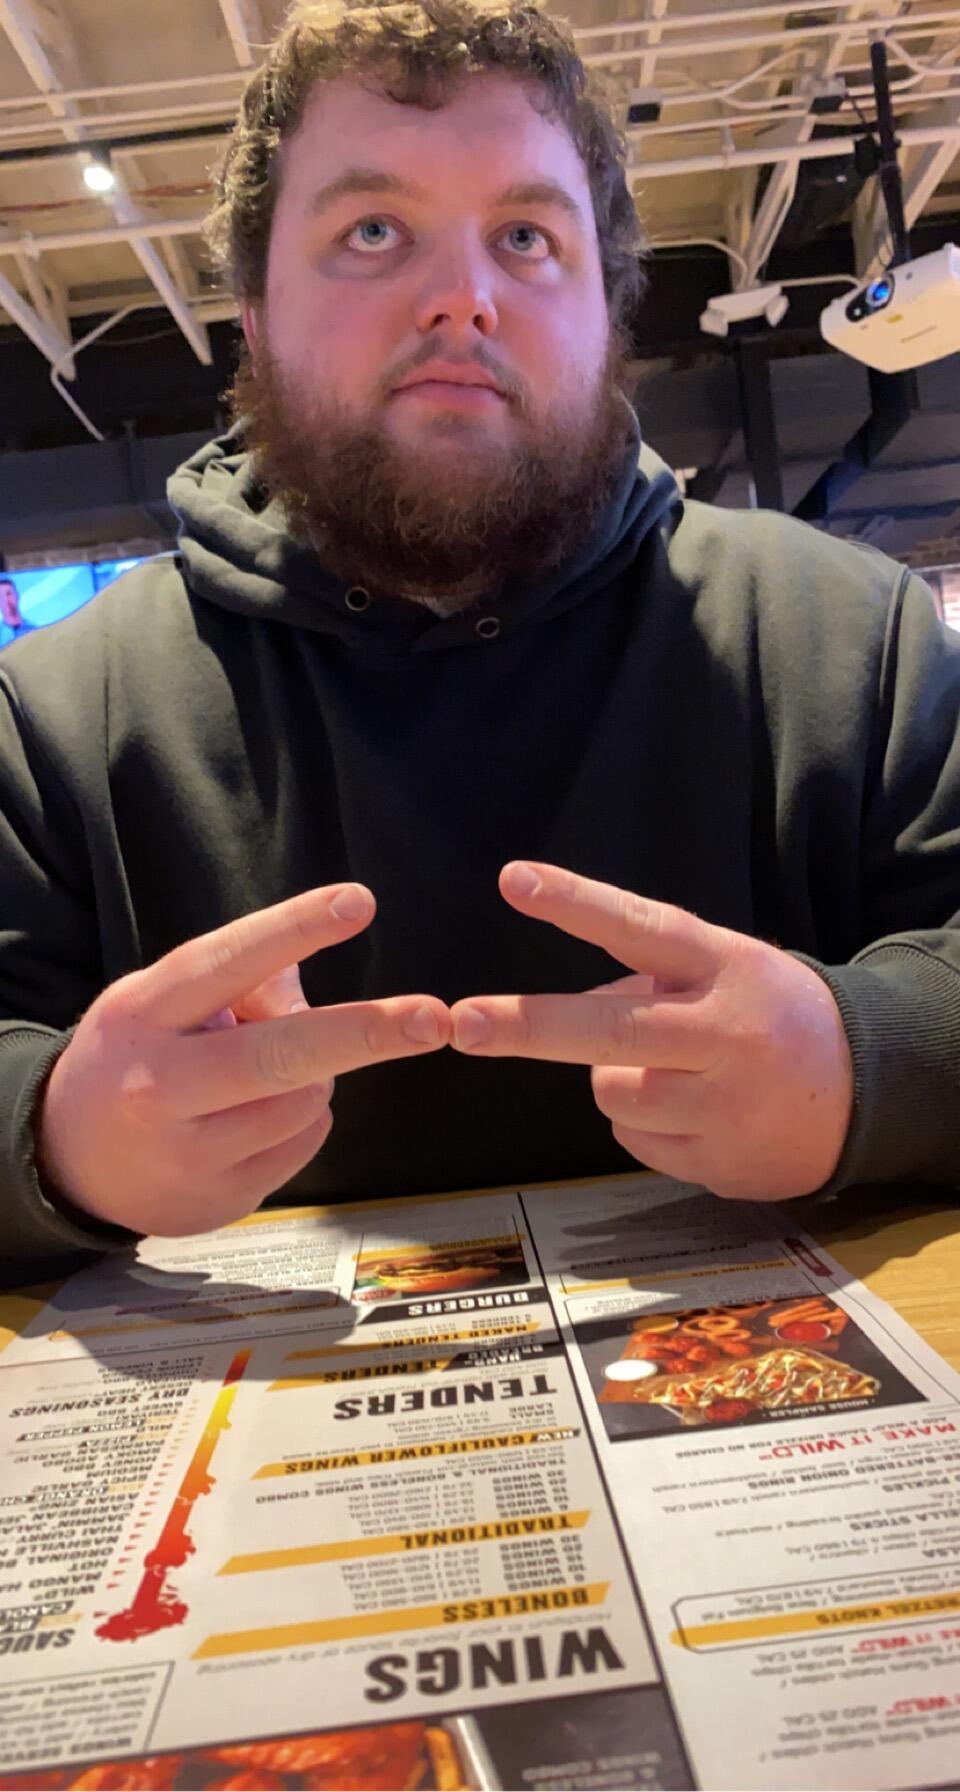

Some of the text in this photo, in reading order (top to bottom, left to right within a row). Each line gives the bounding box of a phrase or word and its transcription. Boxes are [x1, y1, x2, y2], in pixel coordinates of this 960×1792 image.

[407, 1292, 529, 1315] BURGERS
[468, 1325, 528, 1339] NAKED
[380, 1332, 460, 1349] TENDERS
[467, 1344, 544, 1360] BREADED
[322, 1359, 439, 1383] TENDERS
[8, 1388, 190, 1419] DRY SEASONINGS
[332, 1373, 558, 1421] TENDERS
[134, 1400, 183, 1412] SWEET
[768, 1398, 868, 1419] HOUSE SAMPLER
[114, 1408, 179, 1421] TERIYAKI
[25, 1419, 140, 1441] LEMON PEPPER
[135, 1423, 173, 1433] MILD
[535, 1430, 575, 1442] NEW
[880, 1422, 957, 1441] MAKE
[86, 1435, 132, 1447] PIZZA
[369, 1435, 525, 1463] CAULIFLOWER
[848, 1434, 873, 1448] IT
[13, 1439, 166, 1464] PARMESAN GARLIC
[42, 1447, 161, 1467] SMOKY ADOBO
[62, 1455, 158, 1473] HONEY BBQ
[86, 1464, 153, 1478] MEDIUM
[284, 1454, 360, 1475] WINGS
[468, 1459, 567, 1476] TRADITIONAL
[854, 1451, 960, 1475] ER-BATTERED
[31, 1473, 149, 1493] SPICY GARLIC
[369, 1472, 446, 1489] BONELESS
[491, 1469, 565, 1485] 30 WINGS
[745, 1475, 796, 1491] RINGS
[798, 1467, 850, 1483] ONION
[314, 1483, 364, 1496] WINGS
[493, 1477, 567, 1493] 20 WINGS
[552, 1486, 567, 1494] 15
[881, 1475, 950, 1493] PICKLES
[38, 1488, 103, 1501] ORANGE
[85, 1492, 140, 1506] ASIAN
[255, 1490, 310, 1504] COMBO
[495, 1488, 546, 1501] WINGS
[553, 1495, 570, 1503] 10
[32, 1502, 135, 1521] CARIBBEAN
[495, 1497, 547, 1510] WINGS
[499, 1505, 552, 1519] WINGS
[848, 1507, 960, 1532] ELLA STICKS
[0, 1523, 47, 1535] JALA
[16, 1524, 122, 1544] THAI CURRY
[400, 1515, 573, 1549] TRADITIONAL
[14, 1535, 119, 1556] NASHVILLE
[499, 1537, 555, 1552] WINGS
[560, 1534, 581, 1544] 30
[26, 1547, 114, 1565] ORIGINAL
[500, 1547, 557, 1562] WINGS
[562, 1543, 583, 1553] 20
[921, 1546, 960, 1559] LSA
[67, 1559, 108, 1572] HOT
[502, 1556, 560, 1572] WINGS
[566, 1554, 584, 1563] 15
[503, 1567, 561, 1582] WINGS
[567, 1563, 586, 1572] 10
[0, 1572, 102, 1593] MANGO HA
[507, 1577, 566, 1592] WINGS
[442, 1587, 589, 1623] BONELESS
[815, 1595, 960, 1626] RETZEL KNOTS
[363, 1626, 625, 1705] WINGS
[756, 1651, 787, 1665] CAL
[782, 1713, 816, 1728] CAL
[841, 1705, 878, 1720] ADD
